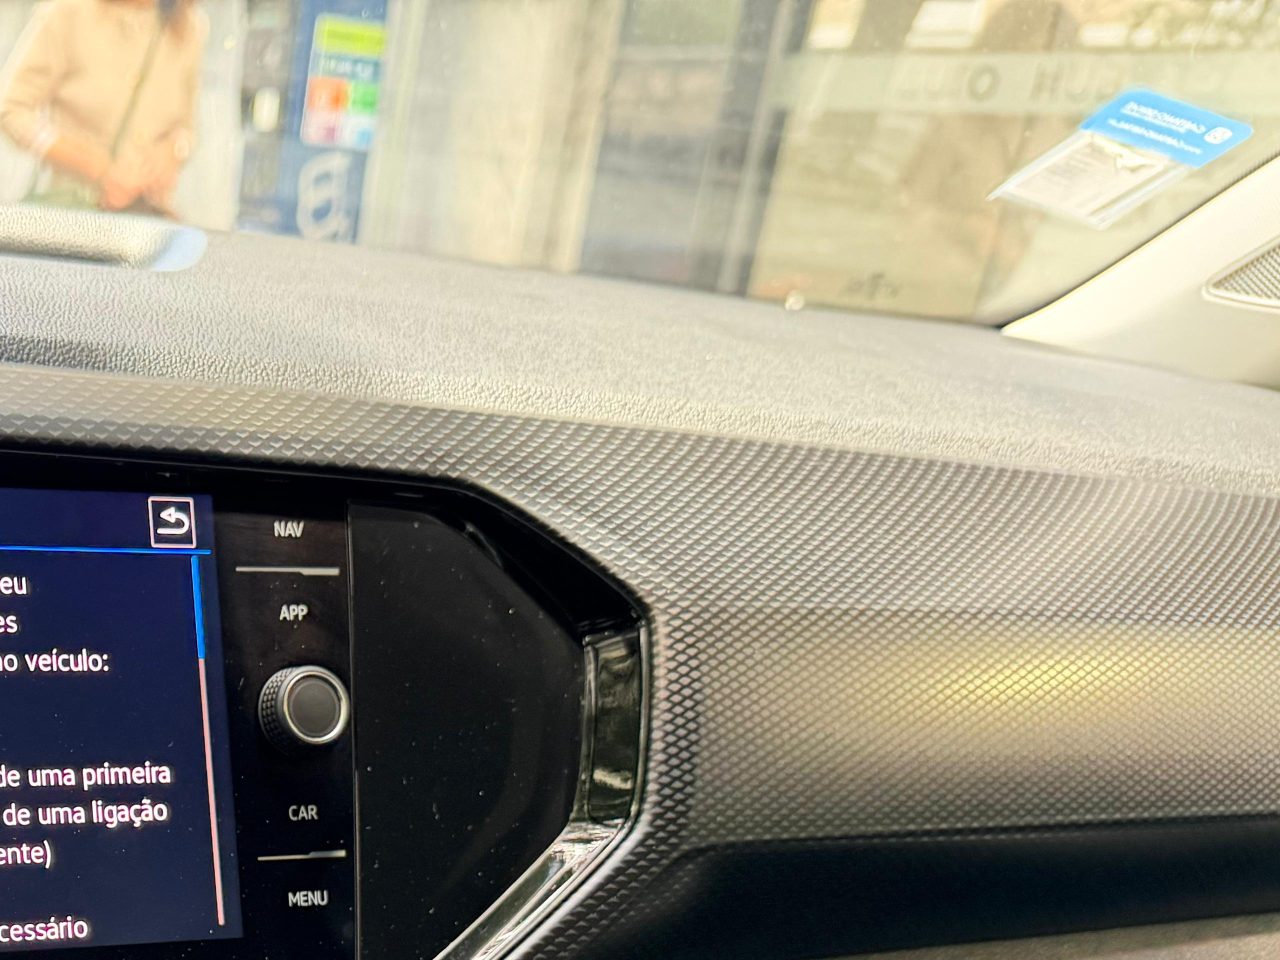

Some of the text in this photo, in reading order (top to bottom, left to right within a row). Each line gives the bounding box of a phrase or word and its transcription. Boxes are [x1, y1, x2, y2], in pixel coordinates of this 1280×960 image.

[273, 520, 304, 538] NAV
[279, 604, 309, 621] APP
[24, 647, 110, 672] veículo:
[27, 768, 76, 787] uma
[82, 760, 172, 791] primeira
[2, 802, 32, 826] de
[37, 806, 86, 825] uma
[91, 796, 168, 829] ligação
[288, 804, 318, 821] CAR
[288, 890, 328, 907] MENU
